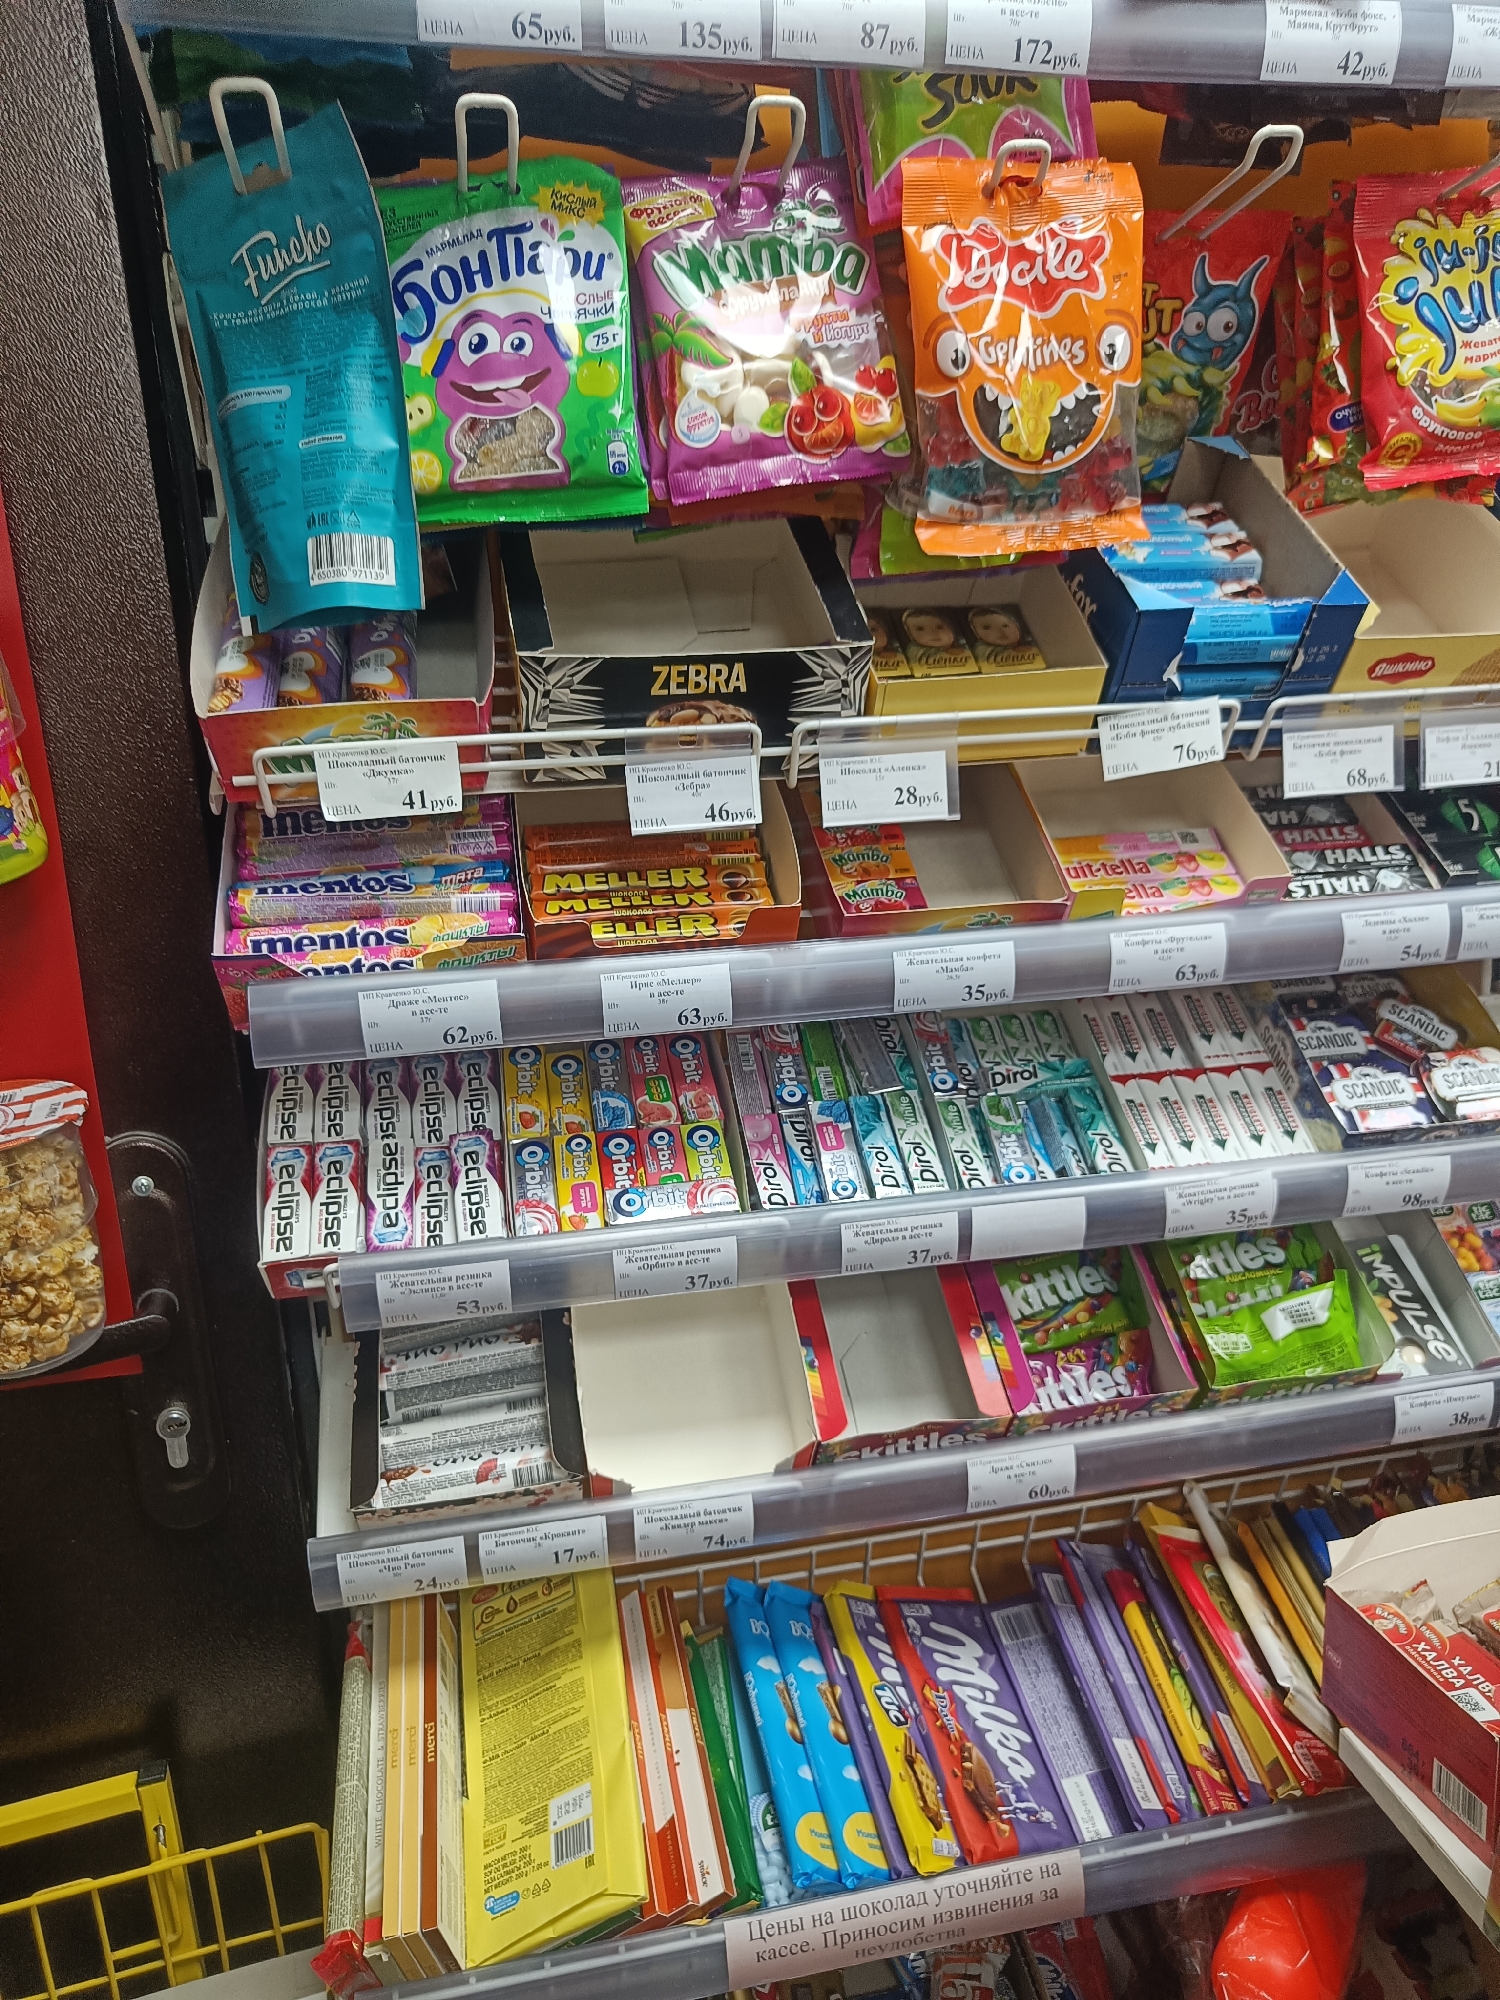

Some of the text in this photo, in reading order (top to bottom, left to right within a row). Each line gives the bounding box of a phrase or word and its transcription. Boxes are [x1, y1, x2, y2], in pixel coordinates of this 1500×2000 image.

[1279, 6, 1328, 20] Мармелад
[424, 19, 464, 36] ЦЕНА
[610, 28, 648, 45] ЦЕНА
[781, 28, 817, 44] ЦЕНА
[950, 43, 984, 60] ЦЕНА
[1265, 60, 1298, 76] ЦЕНА
[1451, 64, 1482, 79] ЦЕНА
[551, 200, 586, 218] МИКС
[425, 228, 483, 259] МАРМЕЛАД
[230, 213, 333, 298] Funcho
[964, 235, 1090, 289] Docile
[653, 235, 870, 310] Mamba
[1372, 656, 1433, 678] ЯШКИНО
[650, 662, 747, 696] ZEBRA
[1109, 708, 1209, 732] Шоколадный батончик
[327, 754, 446, 770] Шоколадный батончик
[840, 764, 926, 776] Шоколад «Аленка»
[1107, 762, 1138, 775] ЦЕНА
[363, 768, 415, 780] «Джумка»
[637, 766, 747, 785] Шоколадный батончик
[674, 779, 711, 793] «Зебра»
[1288, 782, 1315, 792] ЦЕНА
[327, 804, 361, 817] ЦЕНА
[827, 799, 857, 812] ЦЕНА
[634, 817, 667, 829] ЦЕНА
[1282, 826, 1364, 844] HALLS
[831, 851, 892, 866] Mamba
[1324, 843, 1406, 865] HALLS
[255, 872, 416, 896] mentos
[543, 866, 710, 895] MELLER
[1288, 875, 1371, 898] HALLS
[844, 884, 906, 902] Mamba
[249, 927, 409, 954] mentos
[1124, 938, 1162, 948] Конфеты
[1462, 942, 1489, 951] ЦЕНА
[906, 953, 1001, 967] Жевательная конфета
[1343, 958, 1369, 967] ЦЕНА
[935, 965, 975, 975] «Мамба»
[630, 977, 702, 990] Ирис «Меллер»
[1113, 978, 1141, 989] ЦЕНА
[387, 994, 470, 1010] Драже «Ментос»
[897, 997, 927, 1008] ЦЕНА
[607, 1021, 640, 1033] ЦЕНА
[1388, 1003, 1449, 1042] SCANDIC
[369, 1041, 404, 1053] ЦЕНА
[1297, 1031, 1357, 1051] SCANDIC
[670, 1034, 702, 1084] Orbit
[508, 1045, 541, 1096] Orbit
[551, 1054, 584, 1106] Orbit
[991, 1064, 1038, 1088] Dirol
[1342, 1079, 1405, 1100] SCANDIC
[276, 1064, 303, 1140] eclipse
[420, 1066, 448, 1143] eclipse
[515, 1141, 550, 1200] Orbit
[868, 1145, 900, 1189] Dirol
[905, 1140, 940, 1184] Dirol
[954, 1149, 986, 1188] Dirol
[461, 1150, 488, 1236] eclipse
[755, 1160, 788, 1207] Dirol
[271, 1164, 301, 1253] eclipse
[319, 1160, 348, 1248] eclipse
[613, 1186, 687, 1218] Orbit
[852, 1221, 943, 1238] Жевательная резинка
[1168, 1223, 1194, 1234] ЦЕНА
[625, 1247, 721, 1264] Жевательная резинка
[845, 1262, 874, 1273] ЦЕНА
[389, 1271, 492, 1289] Жевательная резинка
[619, 1288, 650, 1299] ЦЕНА
[1001, 1265, 1118, 1321] kittles
[385, 1313, 418, 1324] ЦЕНА
[970, 1499, 998, 1508] ЦЕНА
[644, 1505, 743, 1524] Шоколадный батончик
[494, 1528, 586, 1548] Батончик «Крокант»
[348, 1547, 454, 1570] Шоколадный батончик
[404, 1560, 426, 1571] Рио»
[346, 1592, 378, 1603] ЦЕНА
[1412, 1641, 1466, 1688] ХАЛВА
[875, 1684, 909, 1725] TUC
[920, 1621, 1037, 1788] Milka
[932, 1691, 956, 1735] Daim
[389, 1728, 399, 1769] merci
[406, 1725, 417, 1766] merci
[425, 1722, 435, 1762] merci
[746, 1860, 1062, 1945] Цены на шоколад уточняйте на
[755, 1886, 1059, 1965] кассе. Приносим извинения за
[853, 1926, 966, 1960] неудобства
